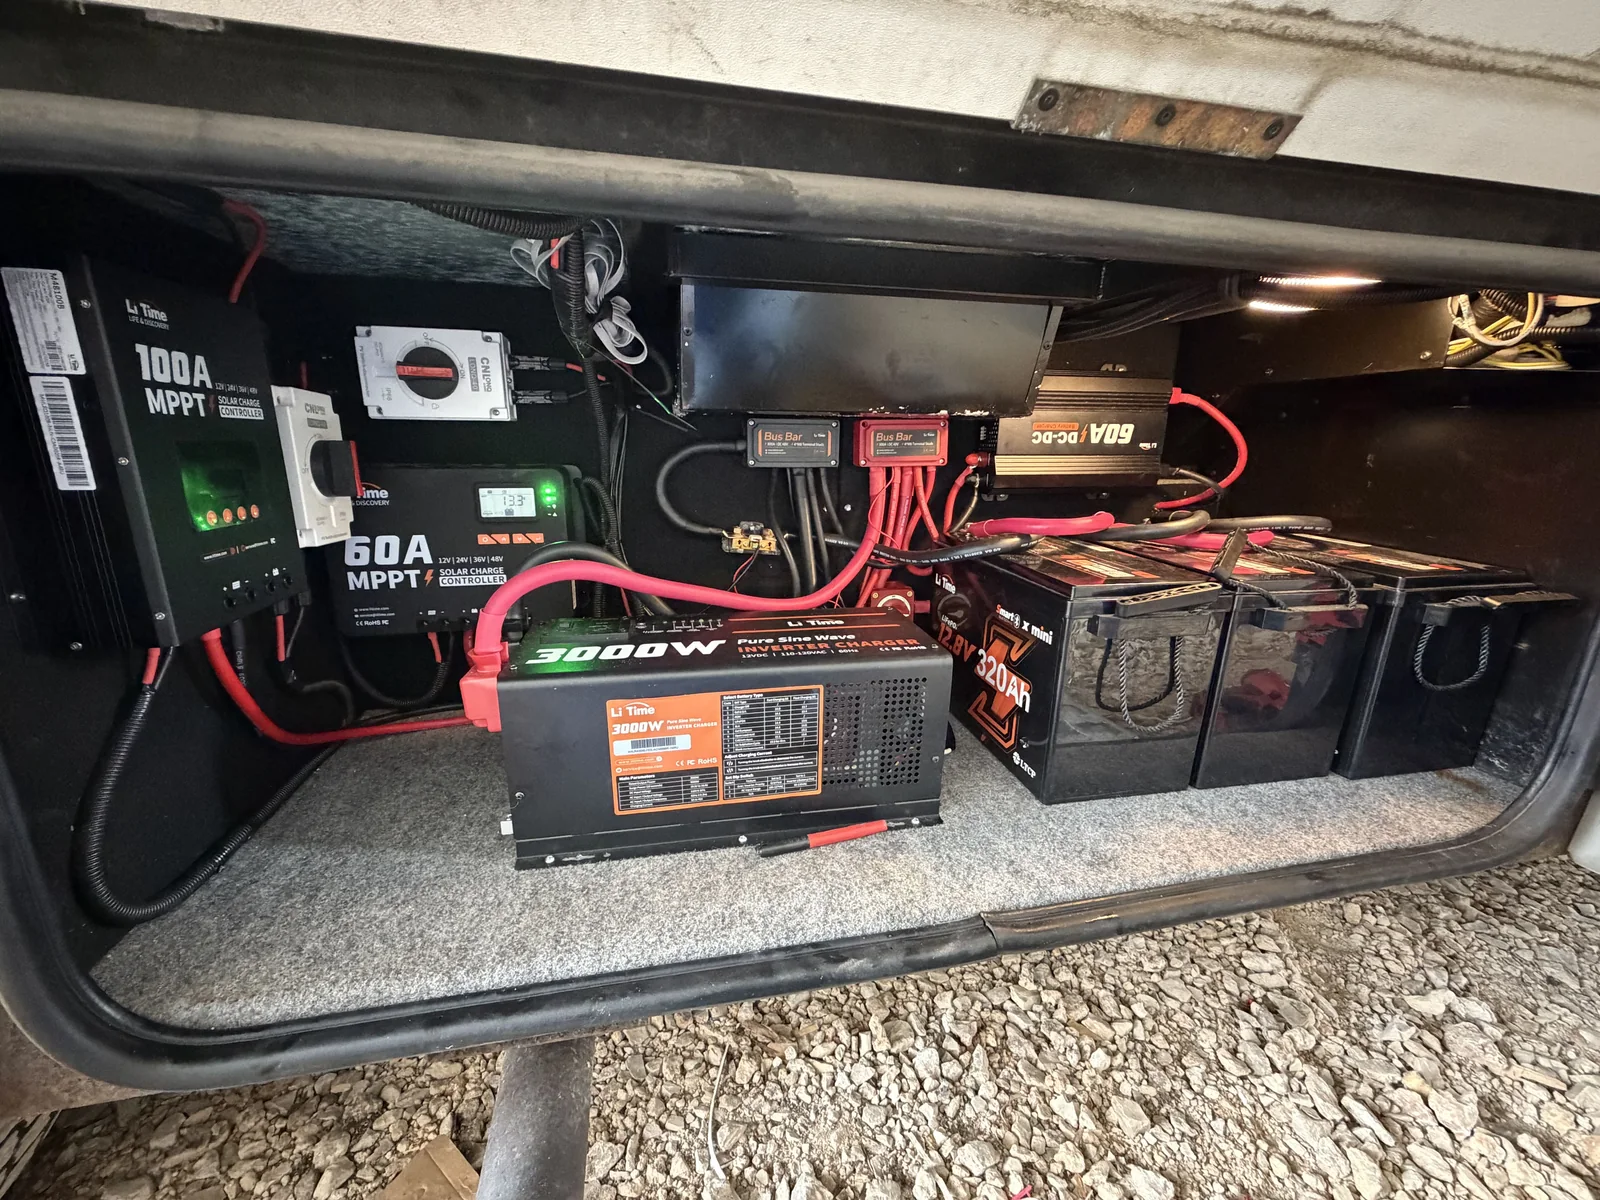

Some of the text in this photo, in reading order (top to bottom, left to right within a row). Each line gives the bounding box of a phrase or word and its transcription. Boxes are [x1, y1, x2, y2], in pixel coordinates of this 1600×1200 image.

[125, 299, 168, 322] Li Time
[135, 343, 212, 389] 100A
[458, 368, 466, 380] ON
[144, 387, 206, 418] MPPT
[218, 395, 260, 408] SOLAR CHARGE
[220, 406, 264, 419] CONTROLLER
[764, 432, 802, 441] Bus Bar
[876, 432, 912, 442] Bus Bar
[1032, 424, 1134, 444] 60A DC-DC
[357, 486, 389, 498] ime
[344, 534, 433, 566] 60A
[440, 566, 504, 576] SOLAR CHARGE
[347, 570, 421, 590] MPPT
[440, 576, 506, 586] CONTROLLER
[935, 574, 956, 594] Li Time
[996, 604, 1015, 622] Smart
[1022, 620, 1030, 632] x
[1031, 624, 1054, 646] mini
[737, 638, 920, 654] INVERTER CHARGER
[778, 635, 812, 643] Sine
[816, 633, 856, 642] Wave
[937, 622, 978, 662] 12.8V
[525, 639, 726, 664] 3000W
[976, 648, 1031, 714] 320Ah
[610, 706, 655, 718] Li Time
[612, 720, 664, 735] 3000W
